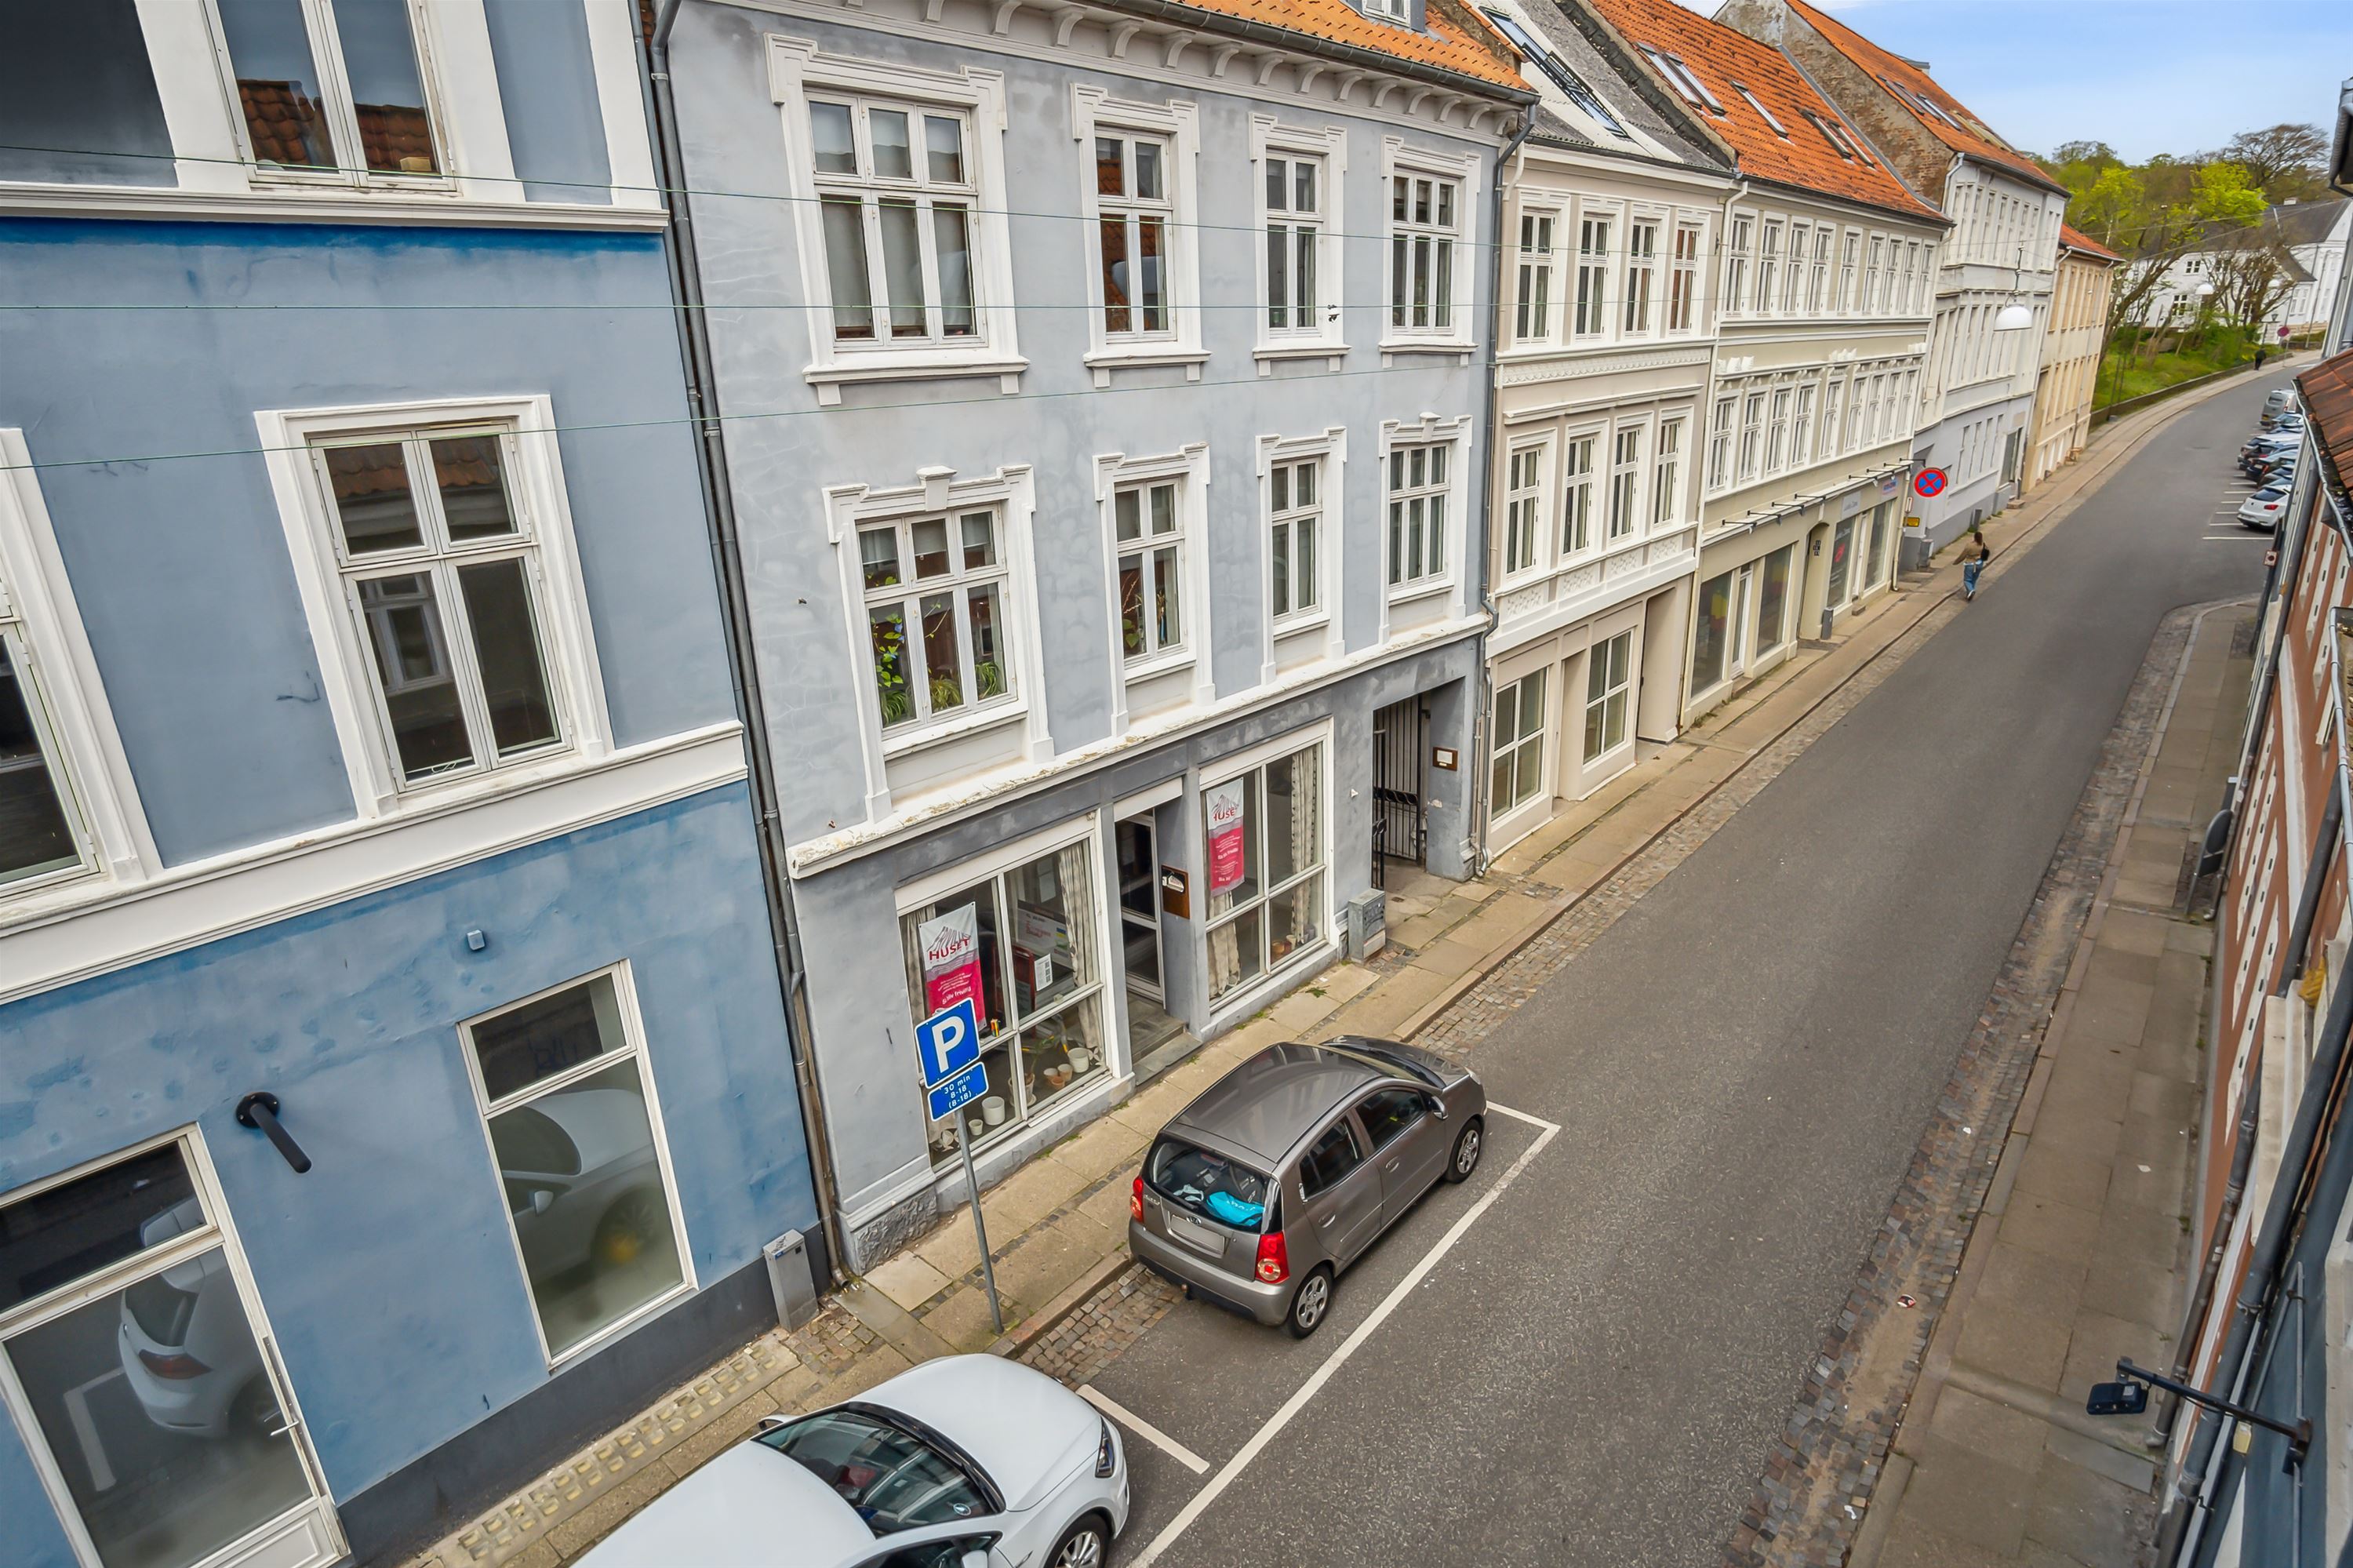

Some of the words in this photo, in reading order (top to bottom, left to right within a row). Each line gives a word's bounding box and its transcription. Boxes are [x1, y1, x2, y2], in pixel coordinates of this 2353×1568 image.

[929, 938, 970, 961] HUSET
[932, 1016, 965, 1073] P
[944, 1083, 955, 1094] 30
[957, 1075, 970, 1086] min
[951, 1084, 967, 1098] 8-18
[949, 1090, 972, 1109] (8-18)
